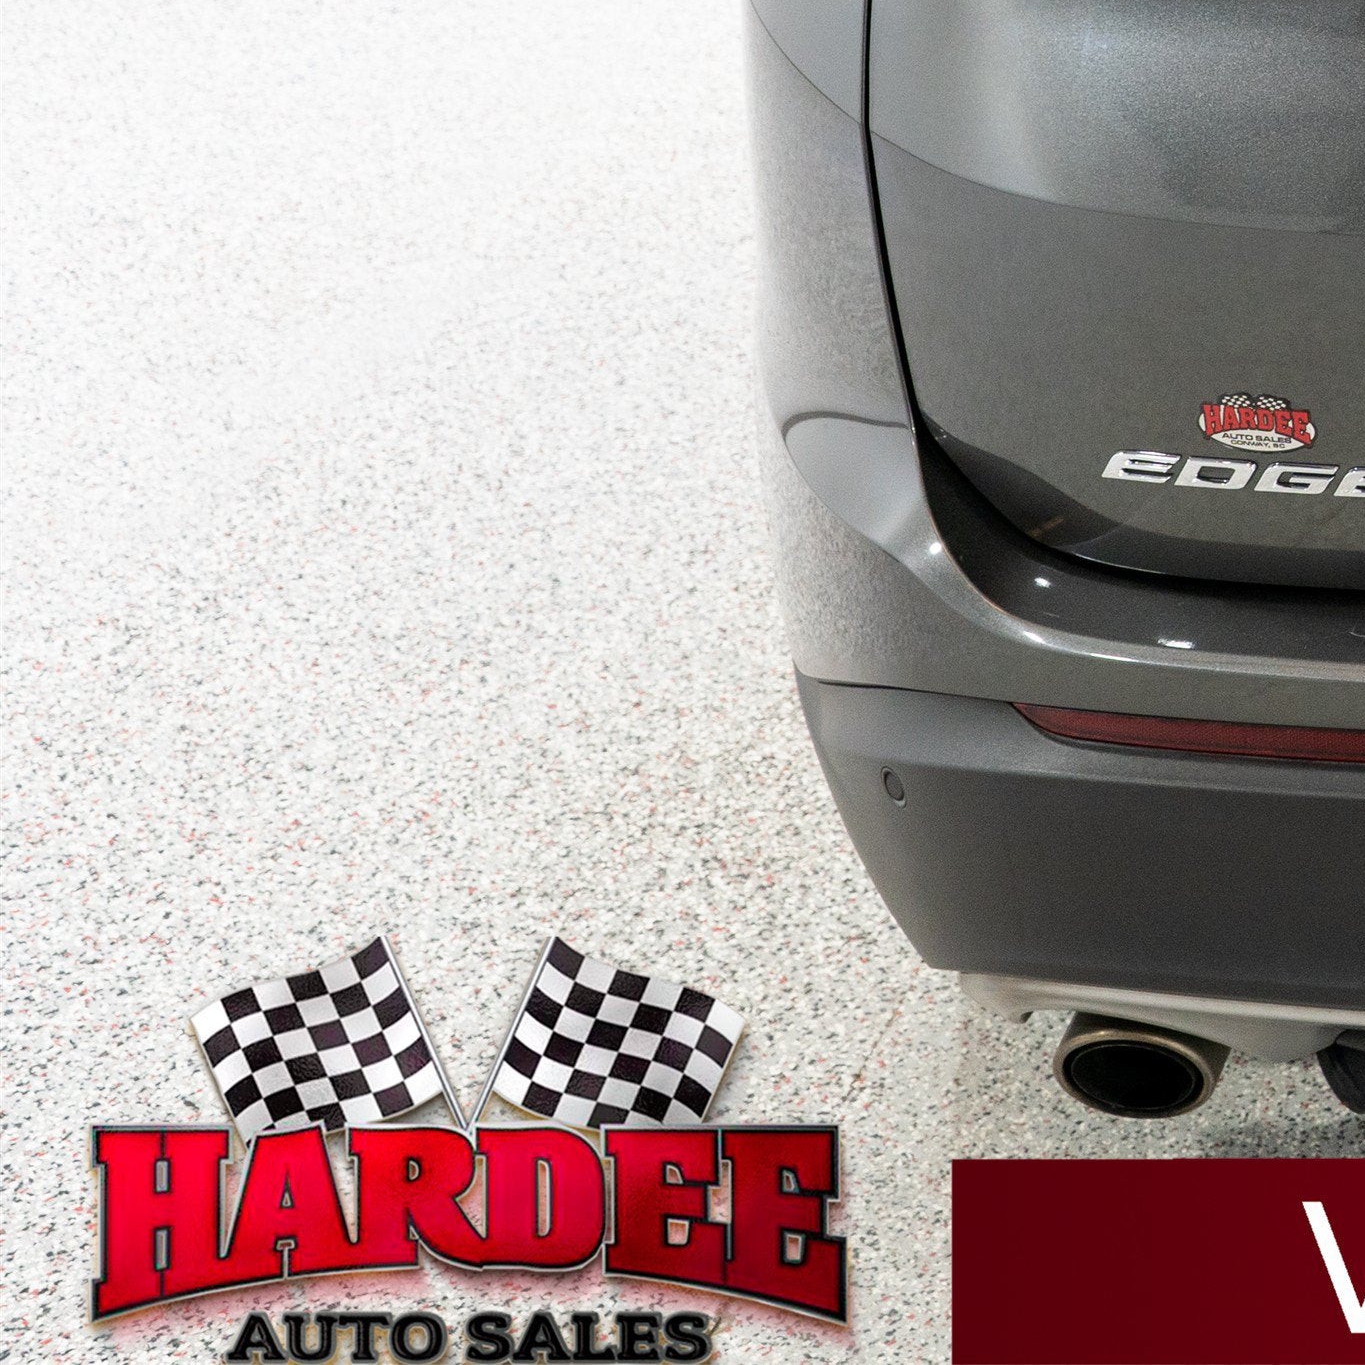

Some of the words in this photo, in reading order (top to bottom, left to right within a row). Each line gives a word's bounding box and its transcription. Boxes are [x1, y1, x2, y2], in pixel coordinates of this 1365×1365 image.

[1203, 404, 1312, 446] HARDEE
[1222, 432, 1254, 441] AUTO
[1255, 435, 1292, 444] SALES
